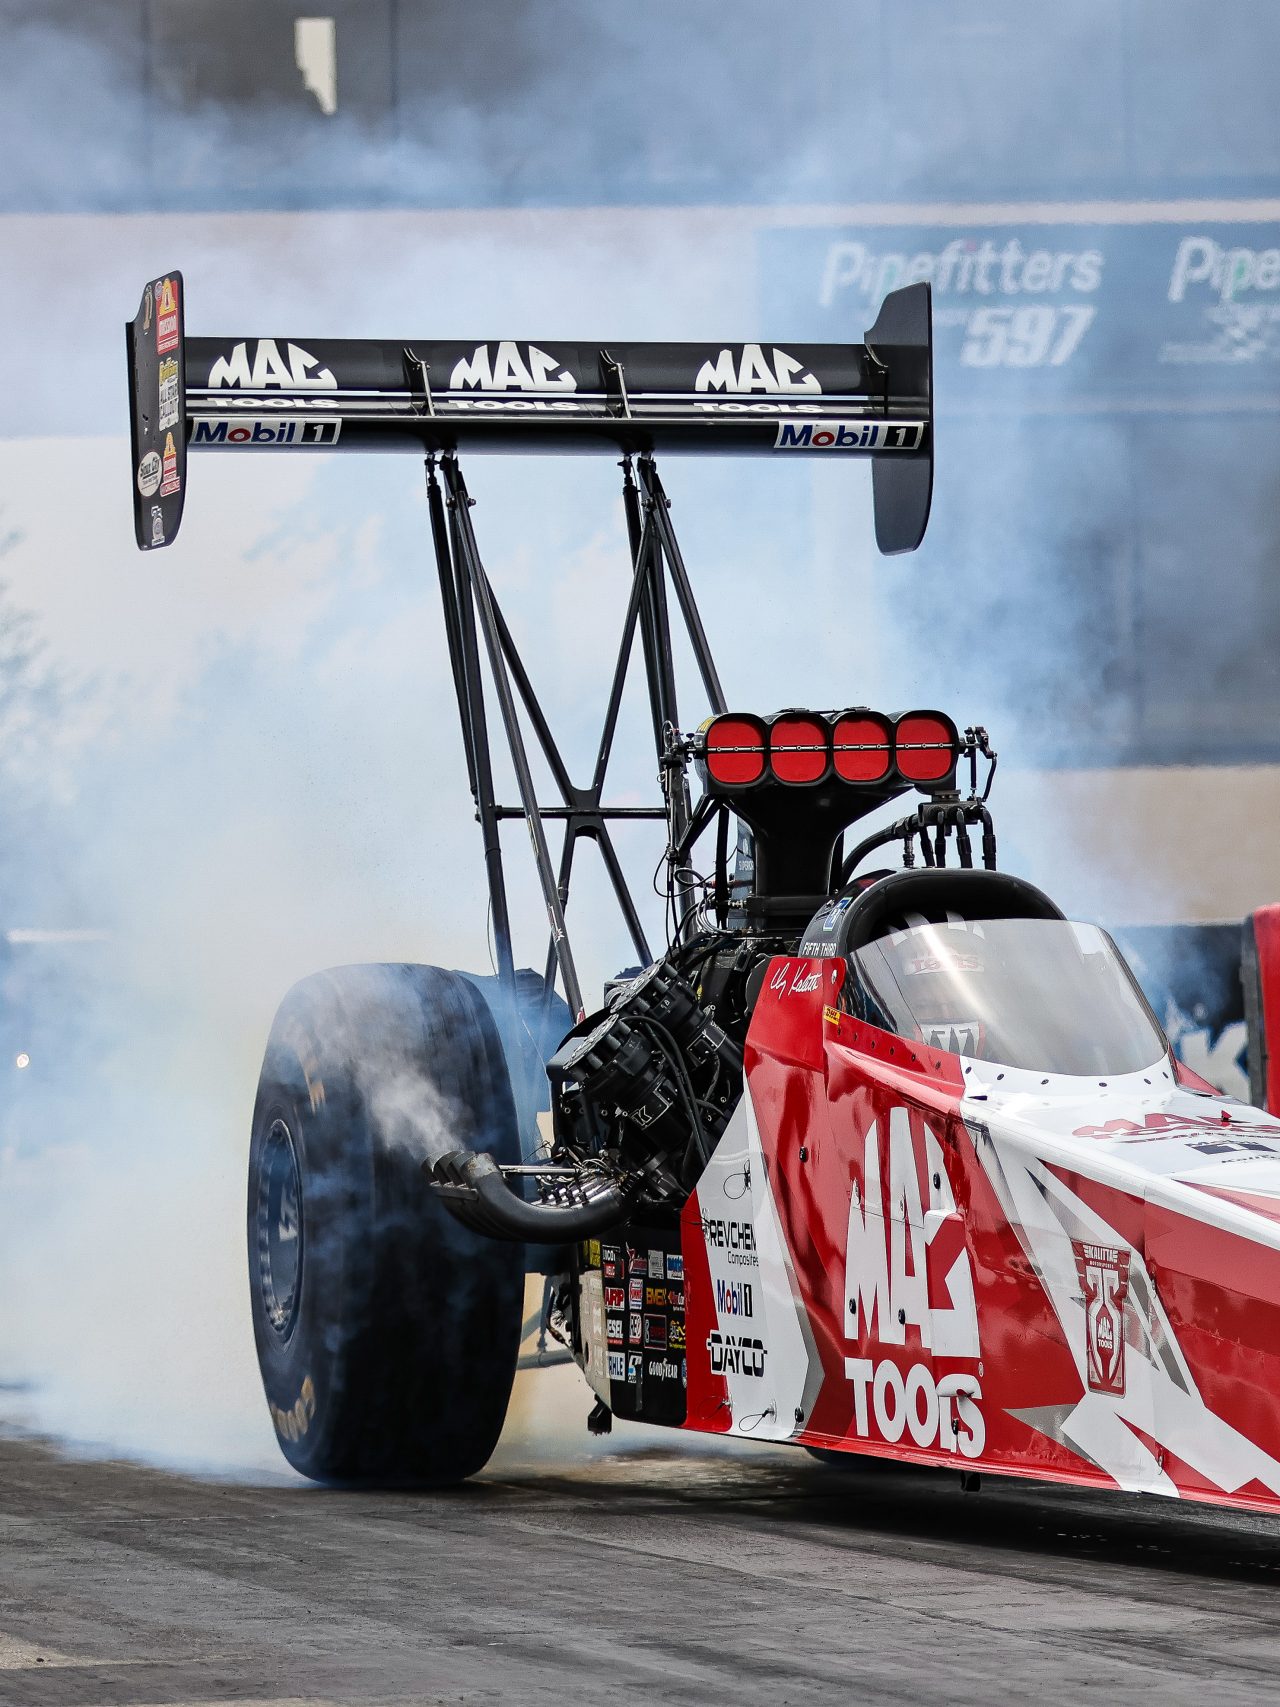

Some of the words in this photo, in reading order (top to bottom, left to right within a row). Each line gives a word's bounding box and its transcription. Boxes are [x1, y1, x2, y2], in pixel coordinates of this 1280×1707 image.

[821, 236, 1104, 306] Pipefitters
[960, 303, 1097, 368] 597
[208, 340, 338, 390] MAC
[450, 341, 578, 393] MAC
[695, 344, 822, 394] MAC
[207, 398, 341, 409] TOOLS
[448, 400, 580, 410] TOOLS
[694, 402, 825, 413] TOOLS
[197, 422, 296, 443] Mobil
[313, 424, 326, 442] 1
[779, 424, 879, 447] Mobil
[895, 427, 910, 445] 1
[802, 942, 820, 956] FIFTH
[820, 942, 837, 957] THIRD
[845, 1107, 981, 1358] MAC
[727, 1250, 760, 1267] Composites
[1084, 1245, 1118, 1263] KALITTA
[717, 1279, 743, 1317] Mobil
[1098, 1316, 1113, 1341] MAC
[707, 1333, 767, 1378] DAYCO
[1098, 1339, 1113, 1350] TOOLS
[608, 1355, 624, 1377] AHLE
[648, 1357, 678, 1381] GOODYEAR
[845, 1357, 987, 1458] TOOLS
